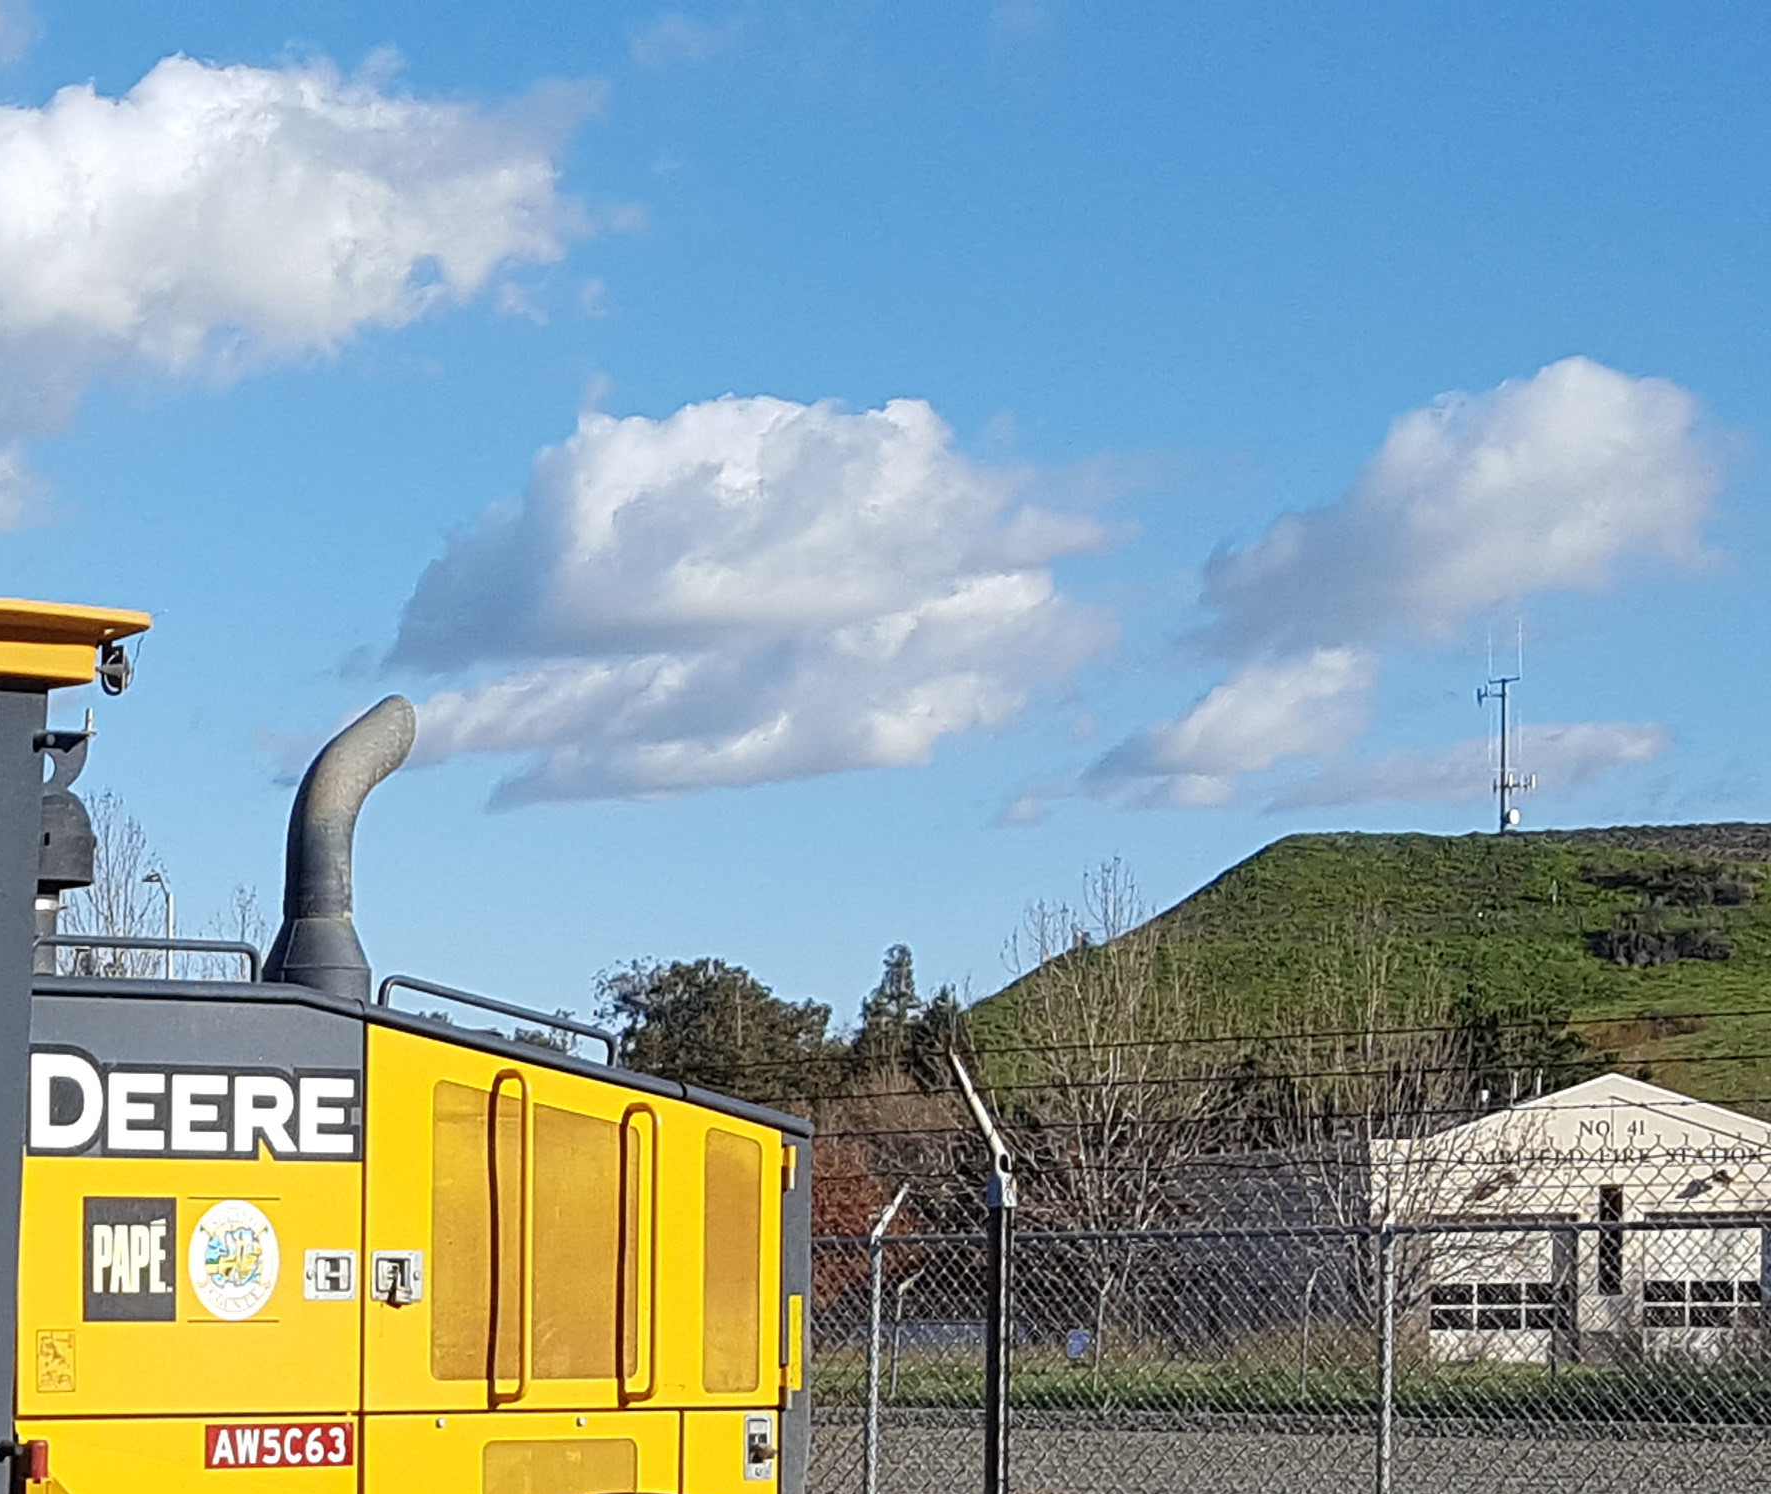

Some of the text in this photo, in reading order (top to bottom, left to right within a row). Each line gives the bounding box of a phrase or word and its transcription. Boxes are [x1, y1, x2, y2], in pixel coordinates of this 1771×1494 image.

[28, 1049, 357, 1155] DEERE
[1627, 1119, 1646, 1137] 41
[211, 1426, 347, 1466] AW5C63
